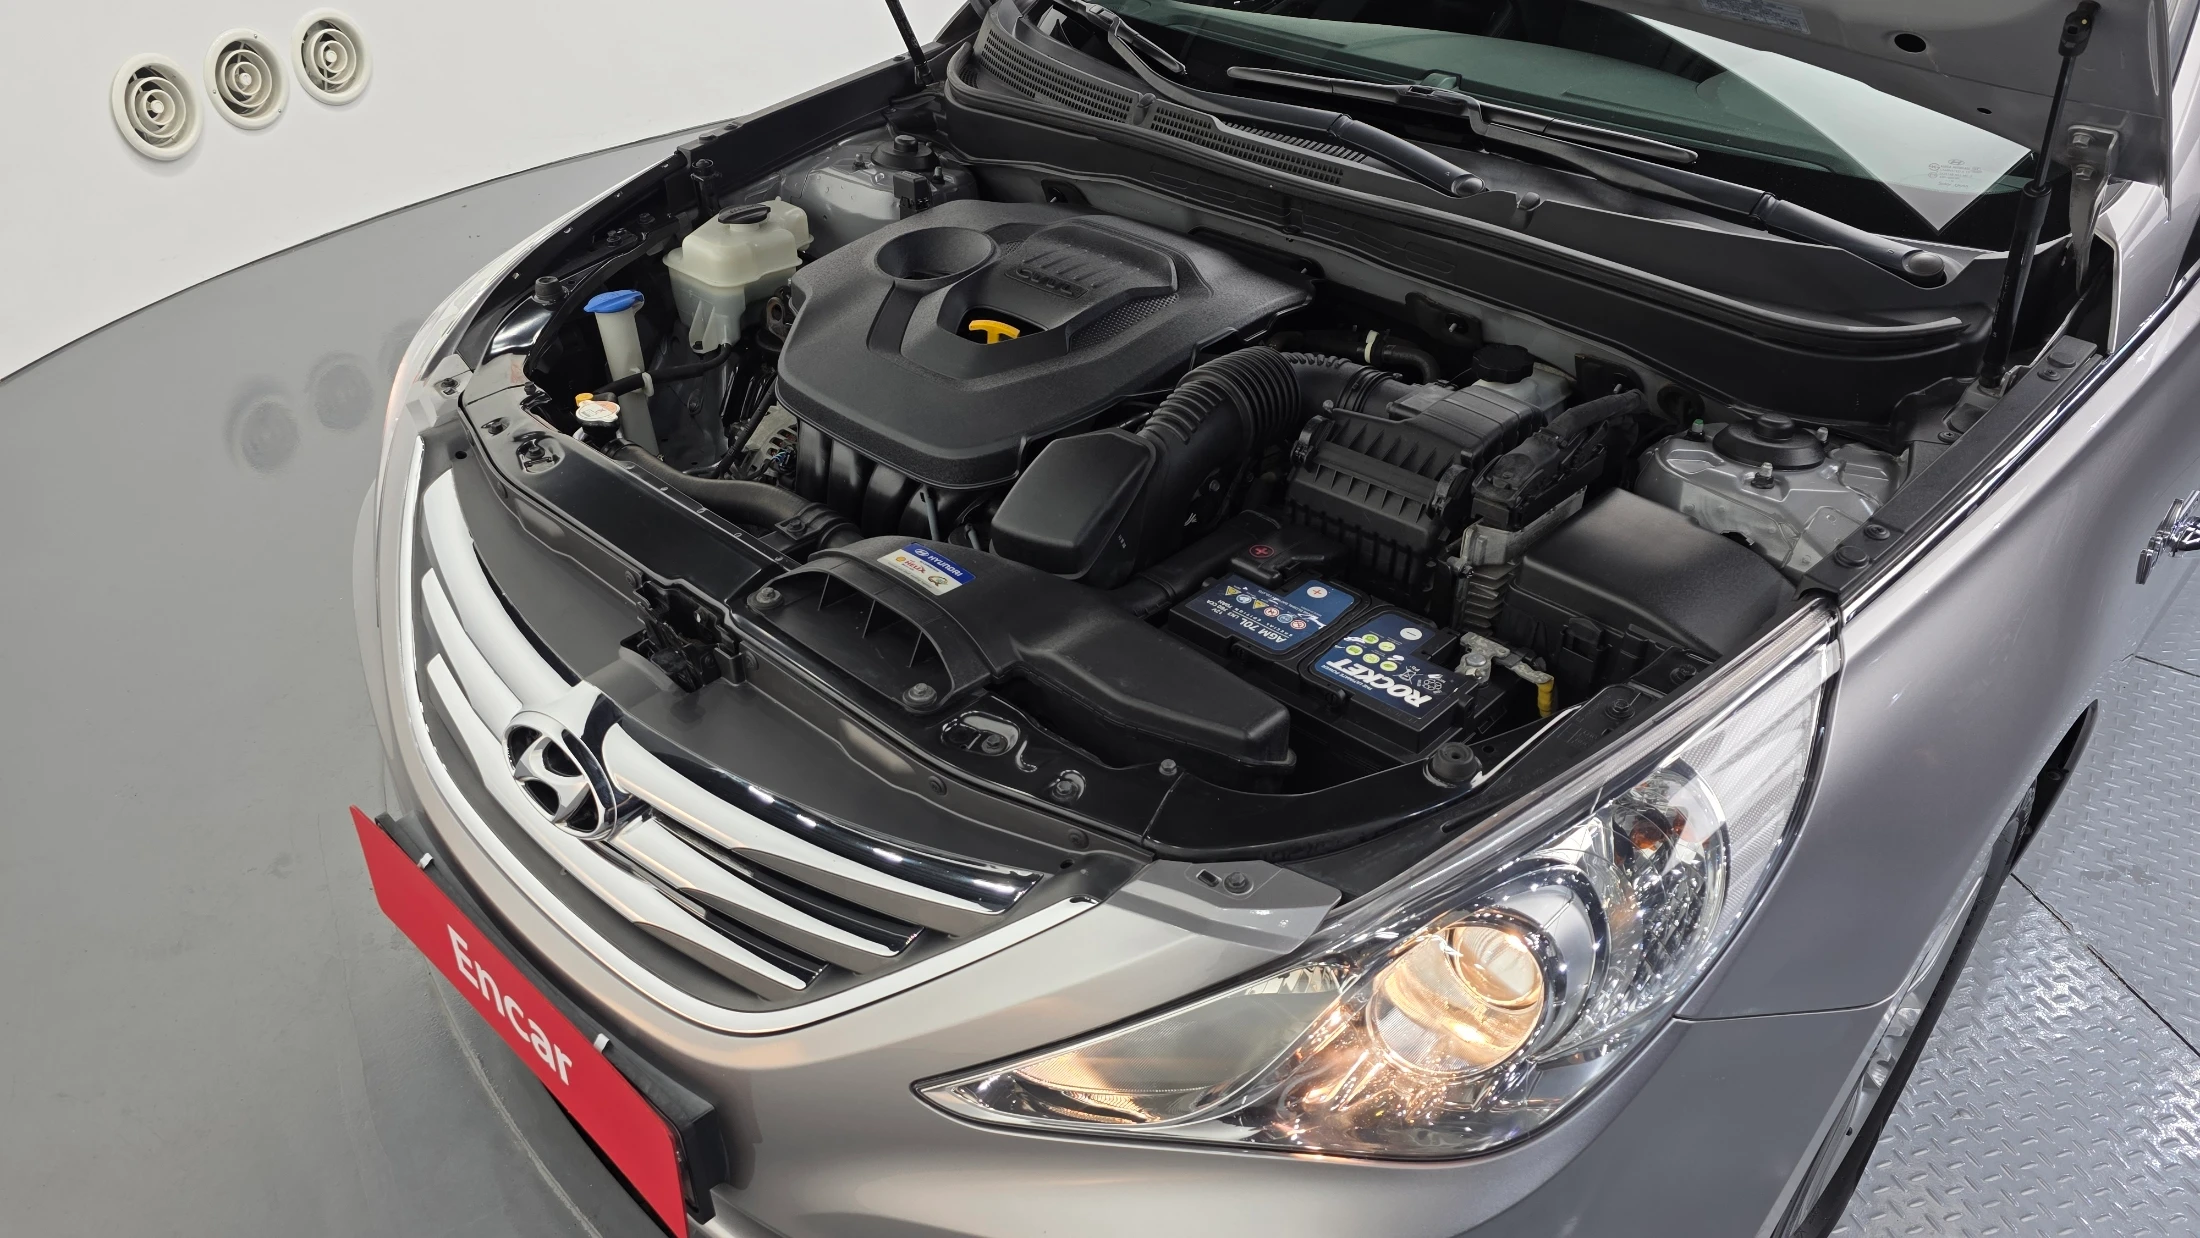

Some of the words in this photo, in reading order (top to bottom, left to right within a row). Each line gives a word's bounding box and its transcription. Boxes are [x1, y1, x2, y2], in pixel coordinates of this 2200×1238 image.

[904, 560, 926, 574] HELIX
[927, 555, 964, 577] HYUNDAI
[1239, 617, 1259, 631] 70L
[1257, 628, 1287, 643] AGM
[1326, 658, 1432, 707] ROCKET
[447, 924, 573, 1086] Encar
